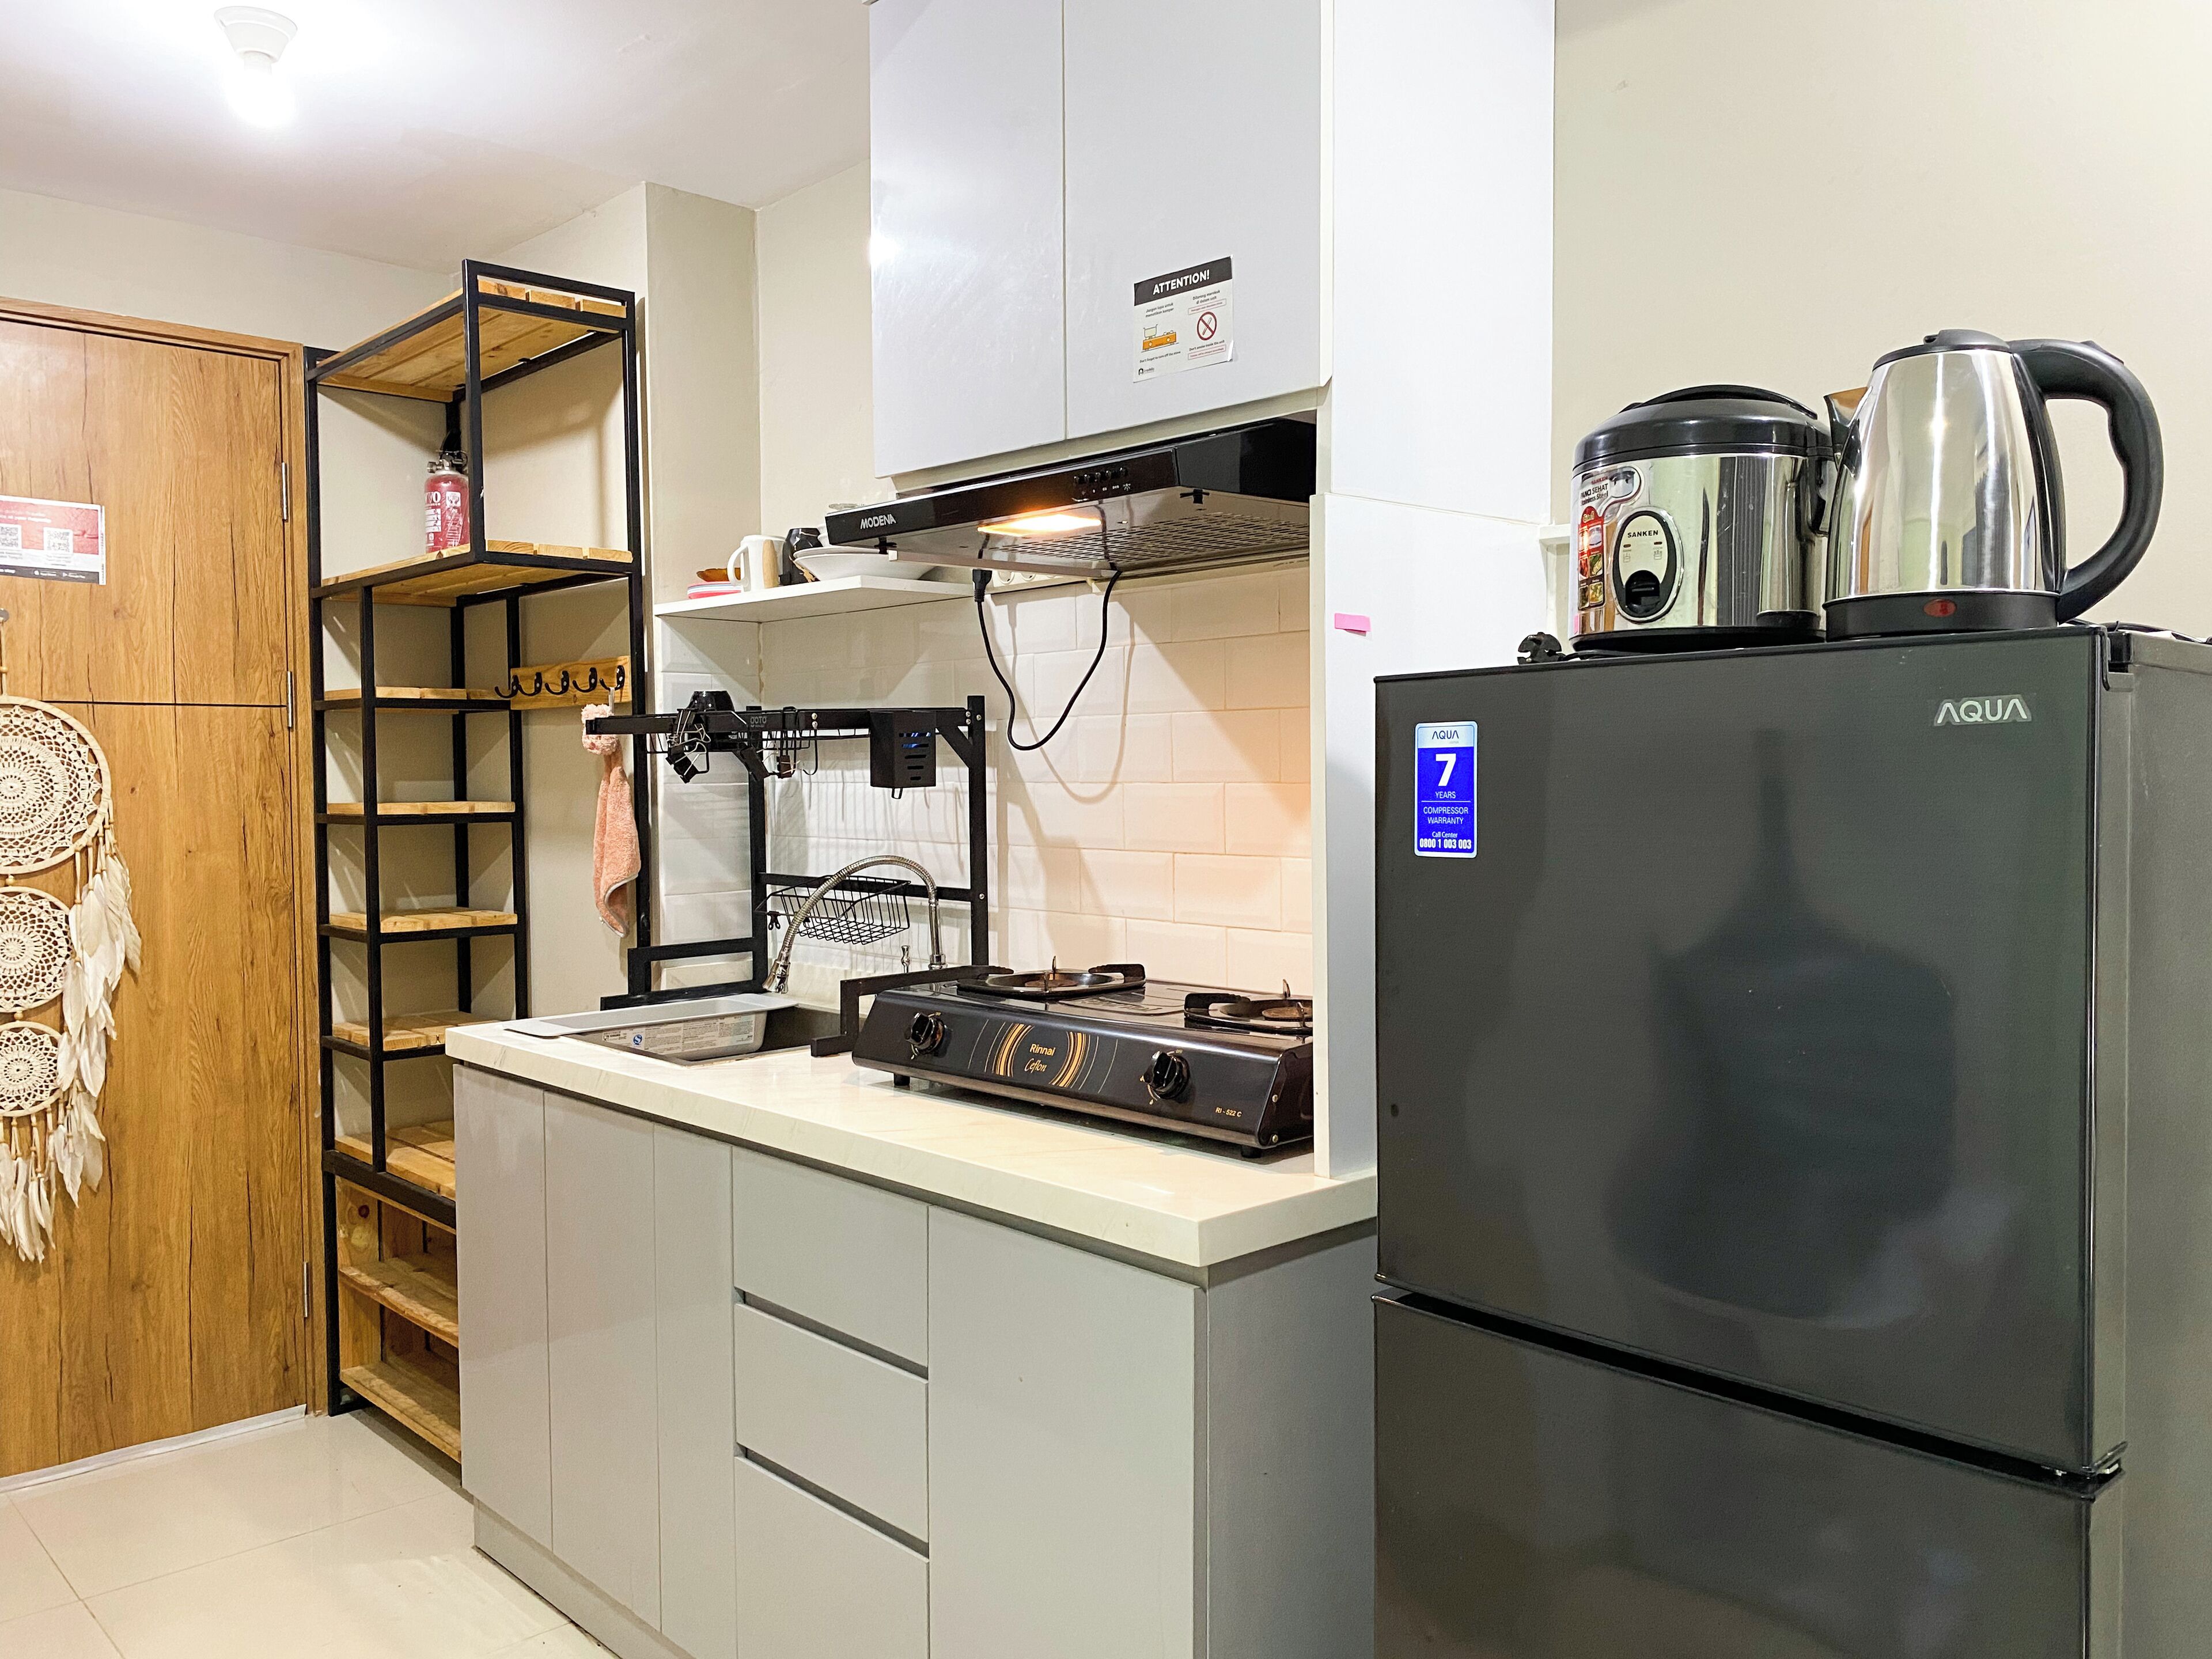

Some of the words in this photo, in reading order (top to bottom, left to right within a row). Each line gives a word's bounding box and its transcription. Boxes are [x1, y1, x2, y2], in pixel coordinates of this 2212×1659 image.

[1153, 269, 1210, 295] ATTENTION!
[1592, 483, 1608, 494] SEHAT
[860, 513, 896, 529] MODENA
[1627, 530, 1658, 538] SANKEN
[1937, 699, 2027, 724] AQUA
[1432, 730, 1459, 740] AQUA
[1435, 753, 1456, 786] 7
[1435, 791, 1456, 799] YEARS
[1419, 838, 1436, 848] 0800
[1438, 839, 1441, 849] 1
[1444, 839, 1457, 849] 003
[1458, 839, 1472, 849] 003
[1029, 1043, 1056, 1056] Rinnai
